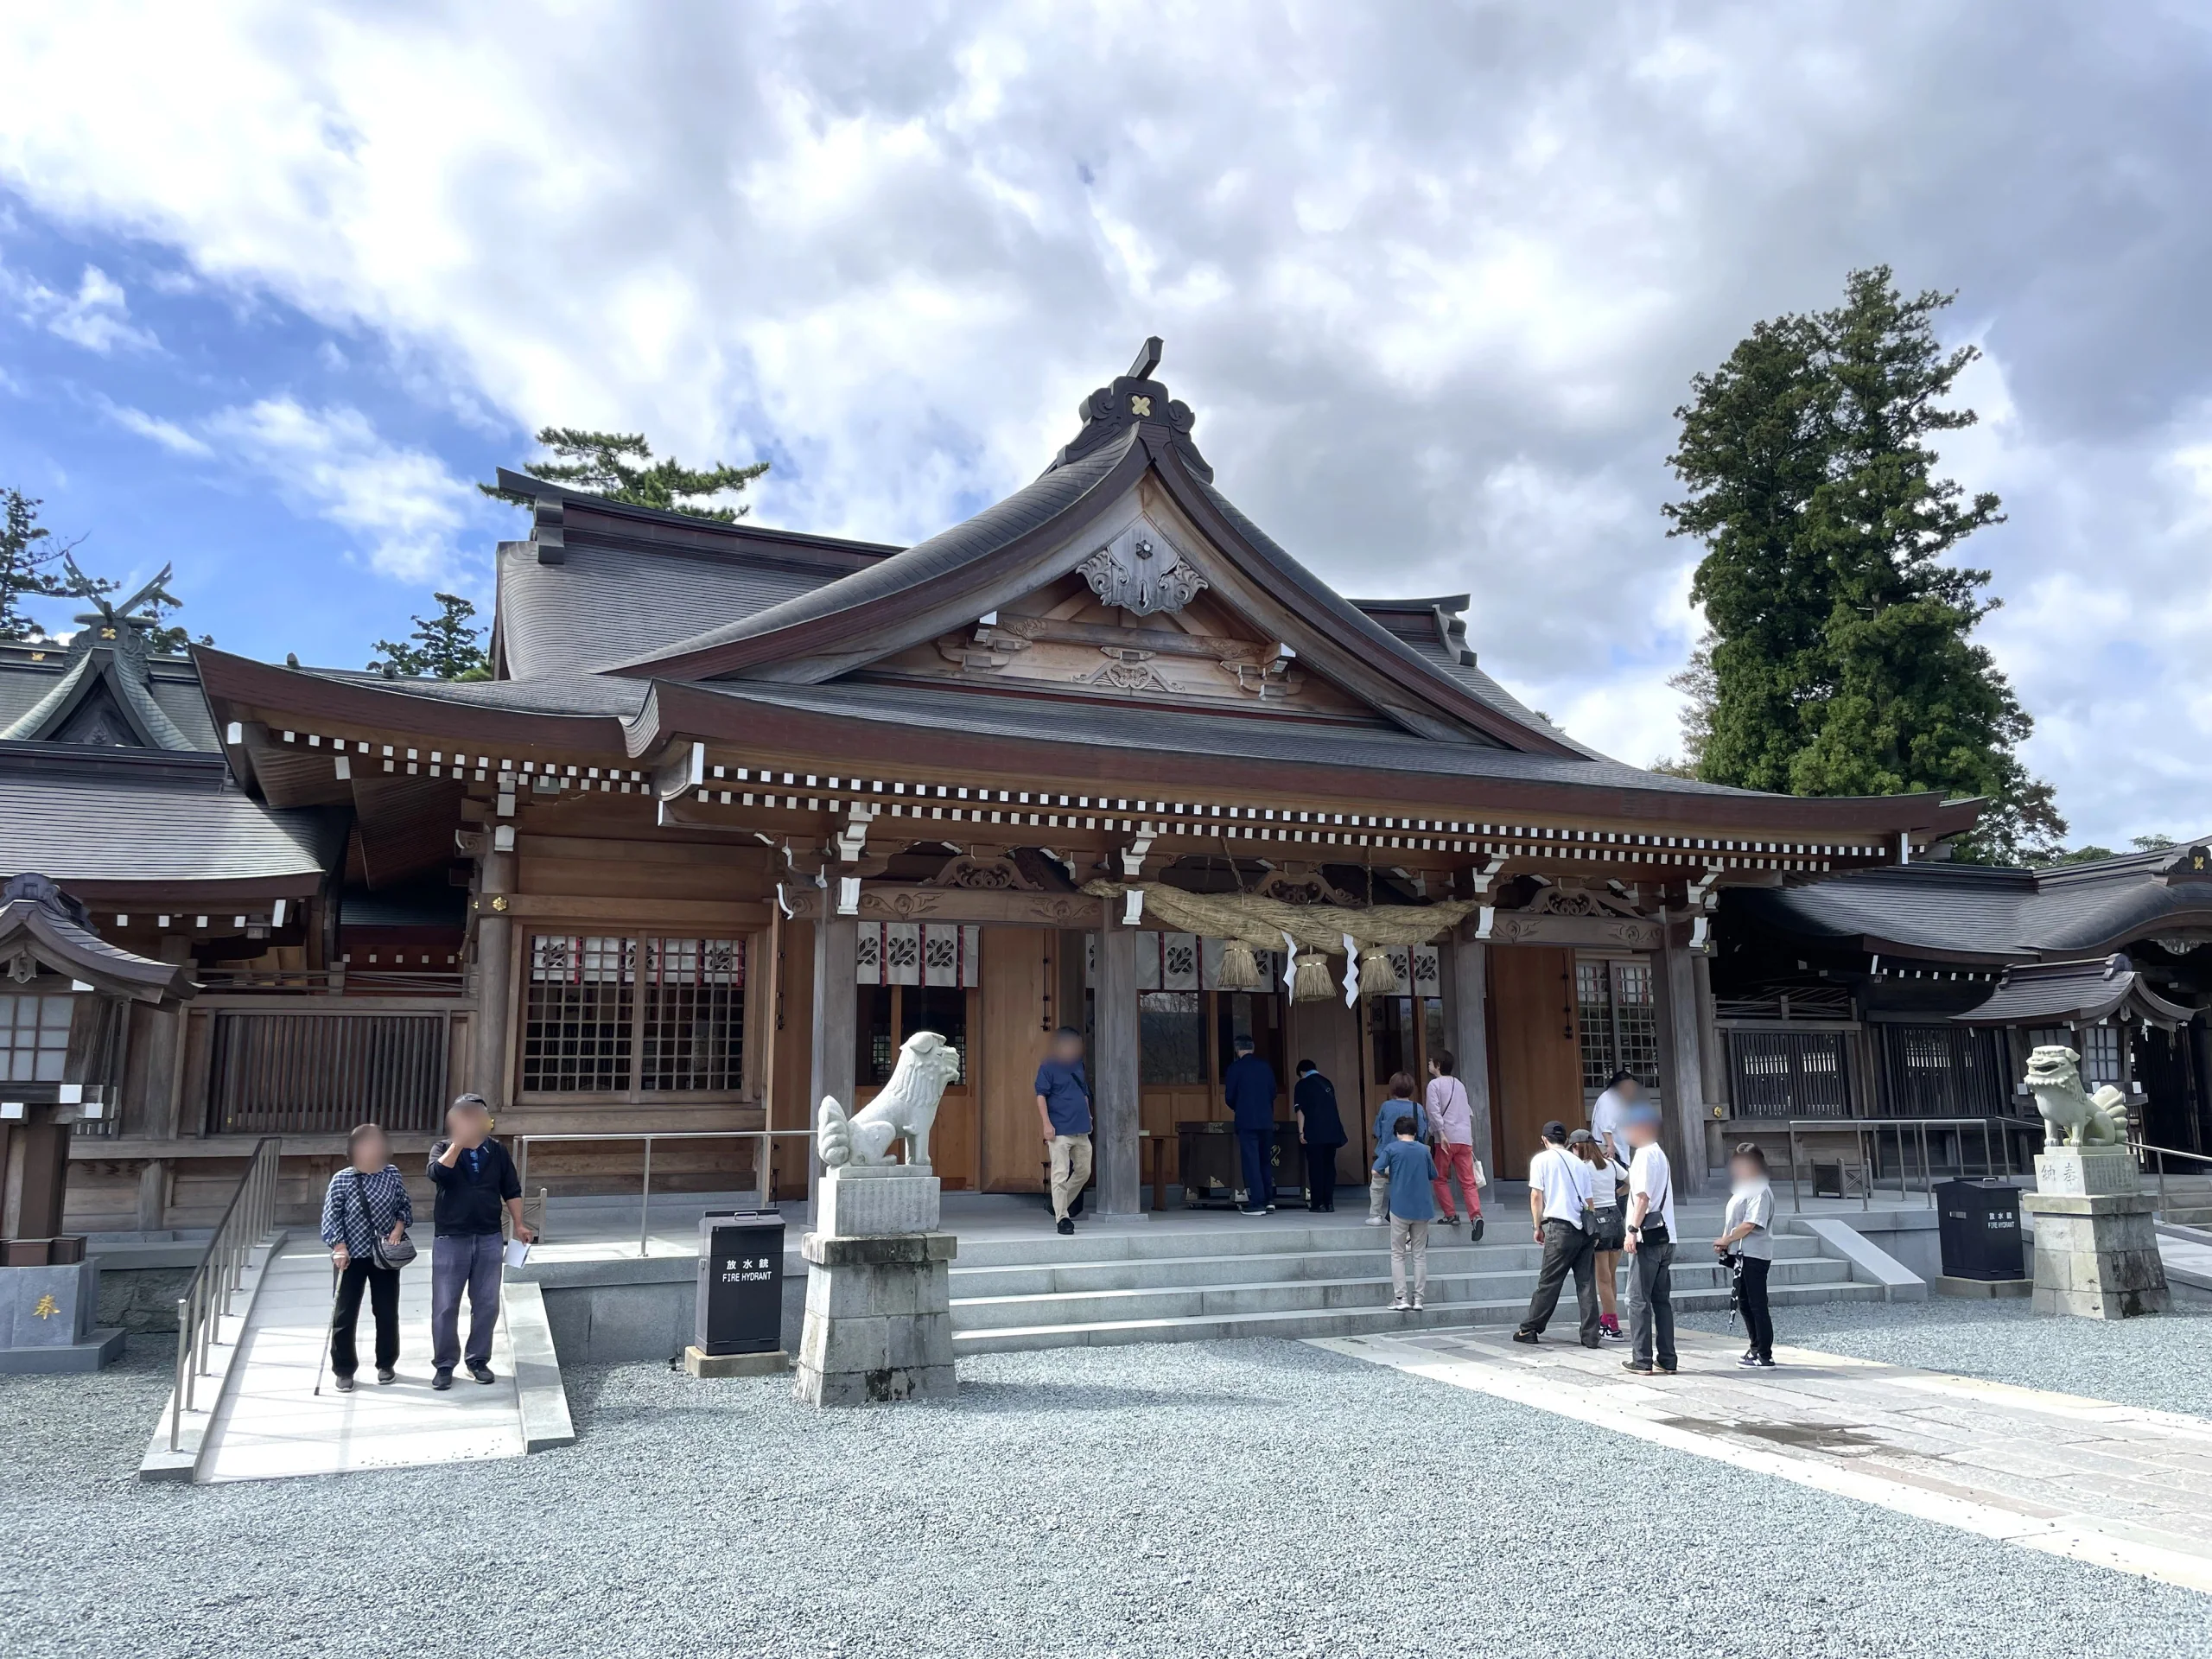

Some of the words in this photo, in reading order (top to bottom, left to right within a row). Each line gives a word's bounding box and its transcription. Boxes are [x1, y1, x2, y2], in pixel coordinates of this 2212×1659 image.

[726, 1258, 769, 1270] 放水銃
[722, 1273, 741, 1282] FIRE
[741, 1271, 772, 1281] HYDRANT
[31, 1294, 61, 1320] 奉
